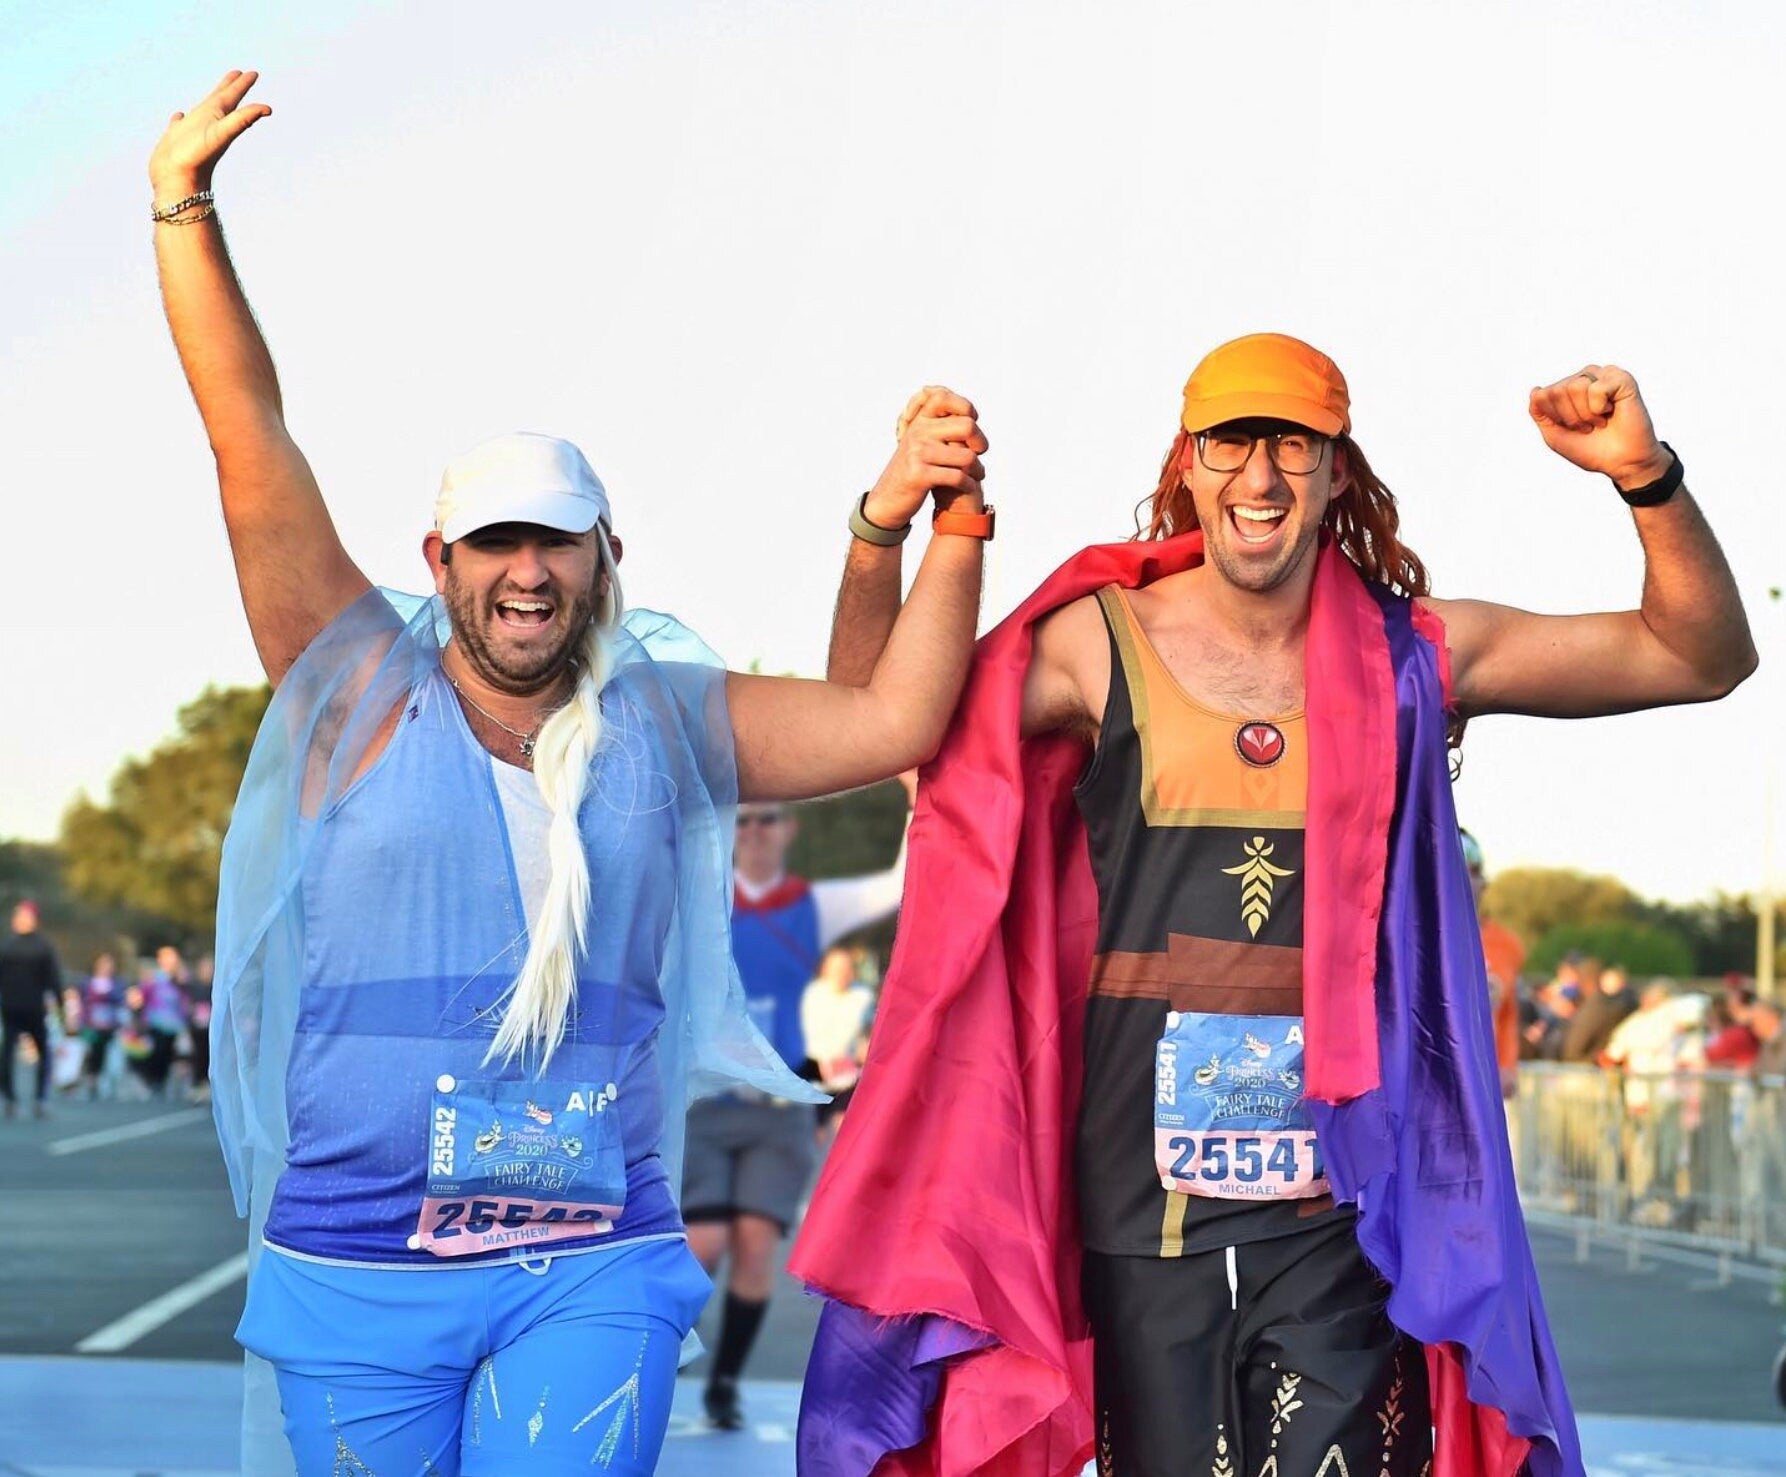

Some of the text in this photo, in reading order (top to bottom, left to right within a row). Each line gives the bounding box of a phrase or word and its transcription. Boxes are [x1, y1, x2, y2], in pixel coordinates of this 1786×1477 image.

[1158, 1042, 1178, 1105] 25541
[1235, 1078, 1266, 1088] 2020
[1216, 1094, 1285, 1108] FAIRY TALE
[1217, 1106, 1285, 1118] CHALLENGE
[433, 1107, 457, 1176] 25542
[516, 1145, 548, 1155] 2020
[1169, 1136, 1325, 1182] 25541
[495, 1163, 566, 1179] FAIRY TALE
[494, 1175, 566, 1190] CHALLENGE
[1219, 1184, 1280, 1195] MICHAEL
[483, 1227, 550, 1246] MATTHEW
